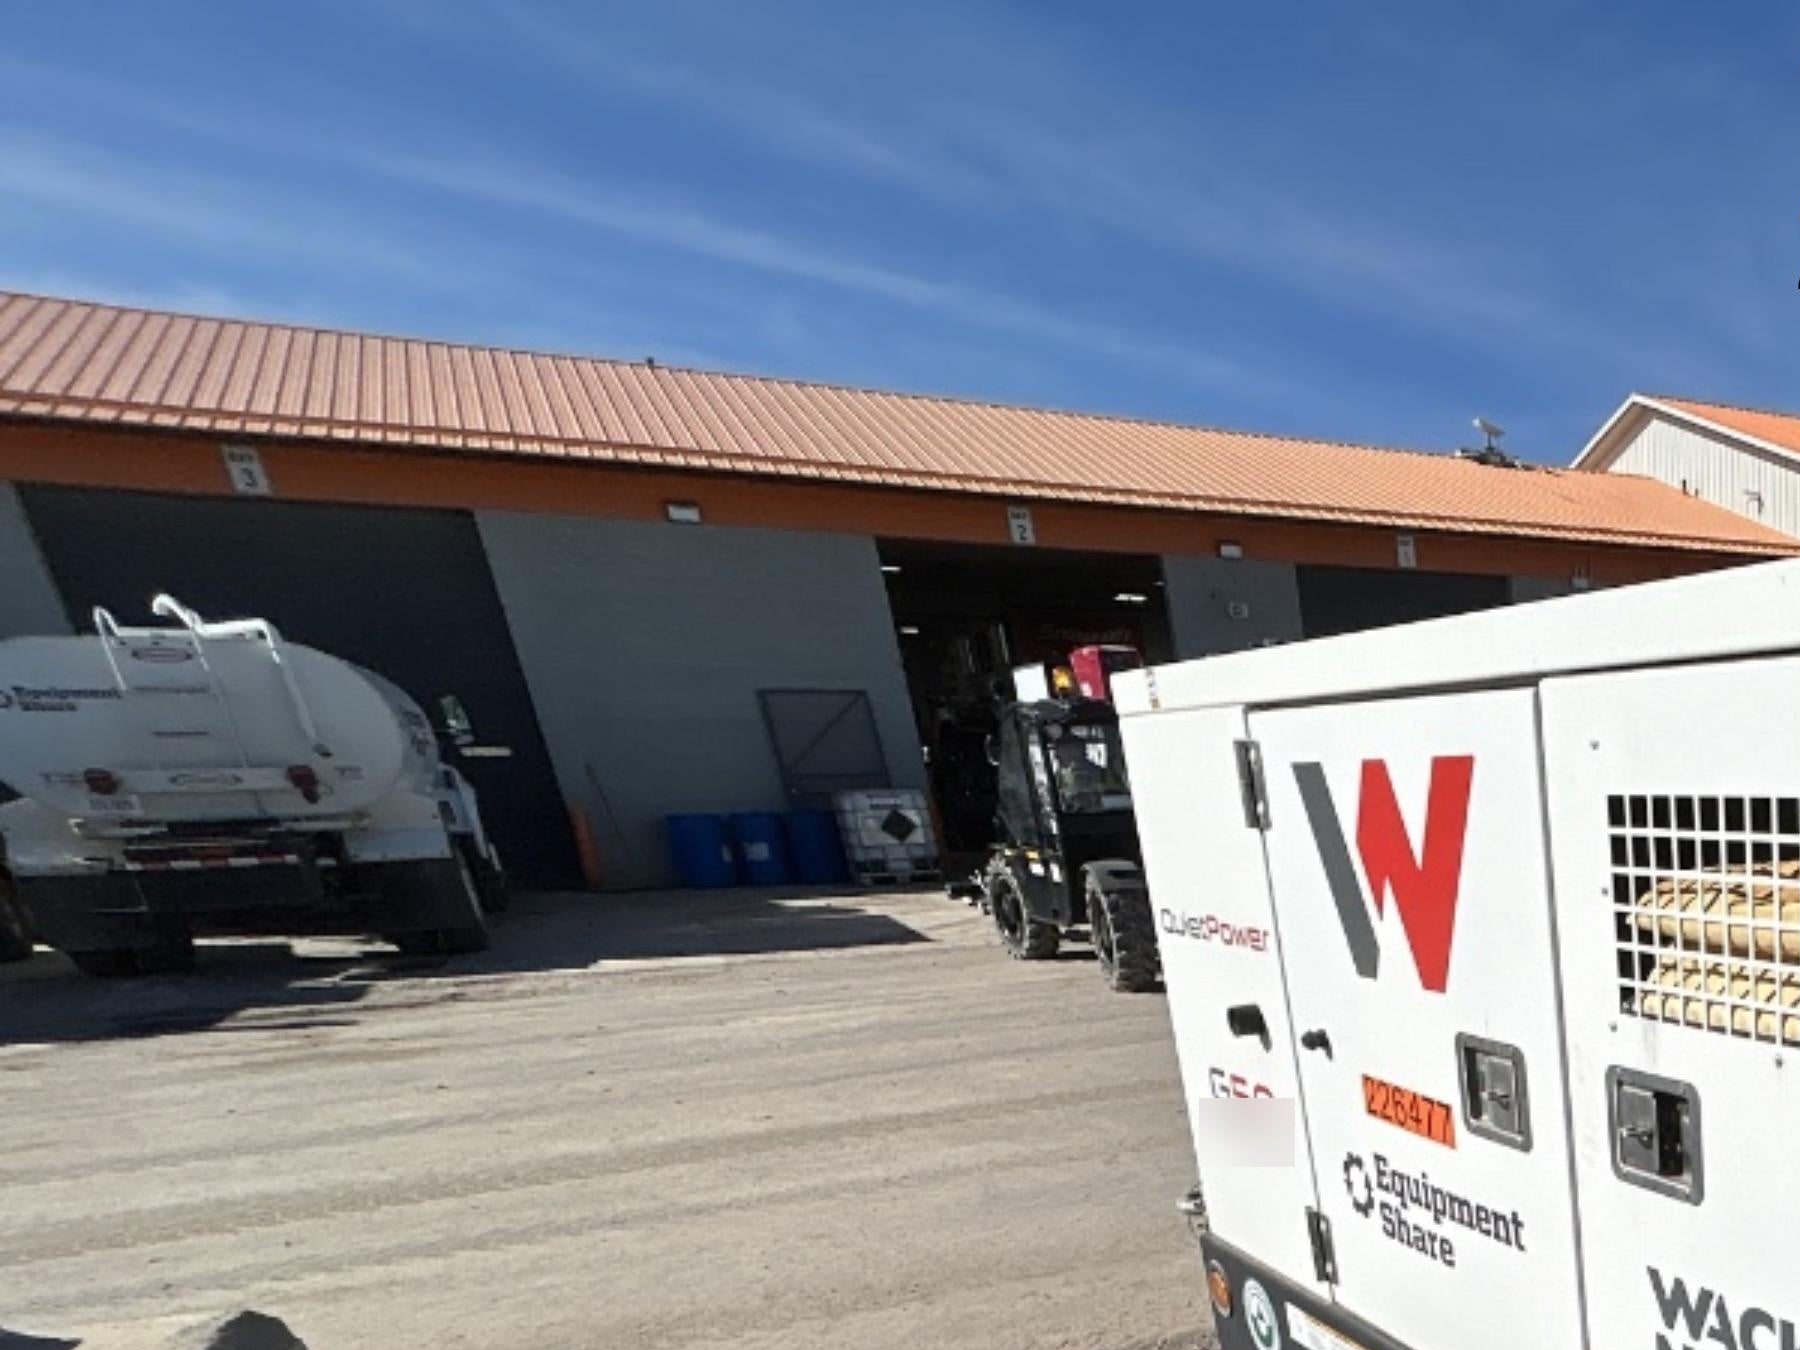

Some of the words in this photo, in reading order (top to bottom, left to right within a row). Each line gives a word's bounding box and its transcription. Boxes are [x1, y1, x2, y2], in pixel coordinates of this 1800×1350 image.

[1016, 524, 1028, 541] 2
[1364, 1076, 1452, 1145] 226477
[1372, 1152, 1527, 1252] Equipment
[1379, 1199, 1456, 1268] Share
